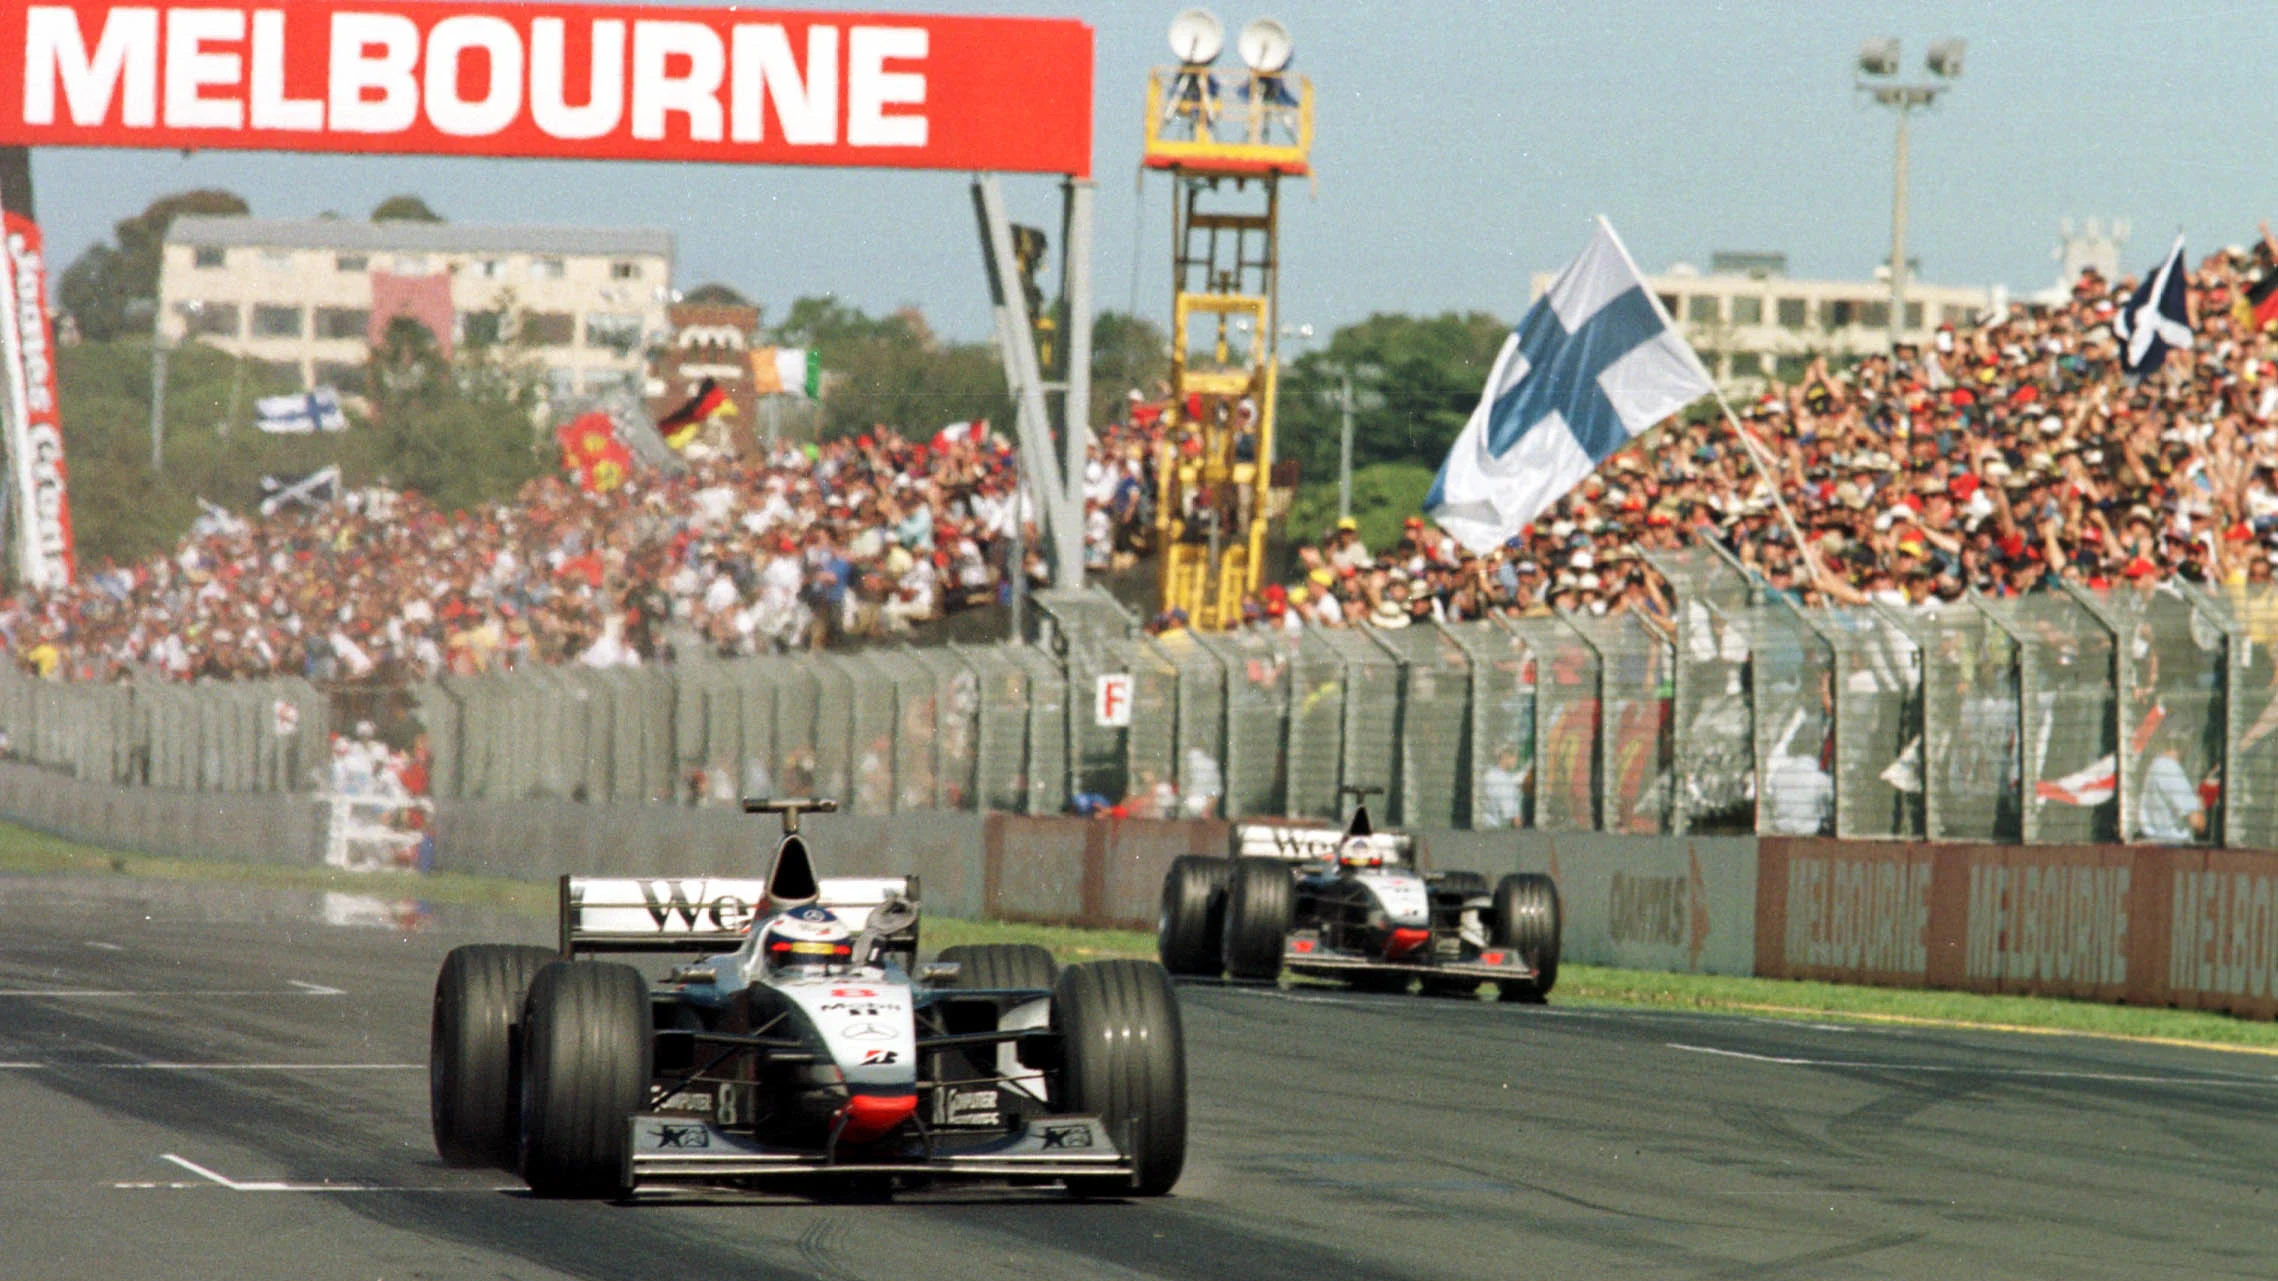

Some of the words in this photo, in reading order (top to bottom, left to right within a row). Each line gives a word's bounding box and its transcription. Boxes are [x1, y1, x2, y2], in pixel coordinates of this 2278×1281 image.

[22, 5, 930, 148] MELBOURNE
[1104, 682, 1126, 718] F
[636, 879, 752, 932] We
[1785, 858, 1934, 974] MELBOURNE
[1966, 864, 2132, 984] MELBOURNE
